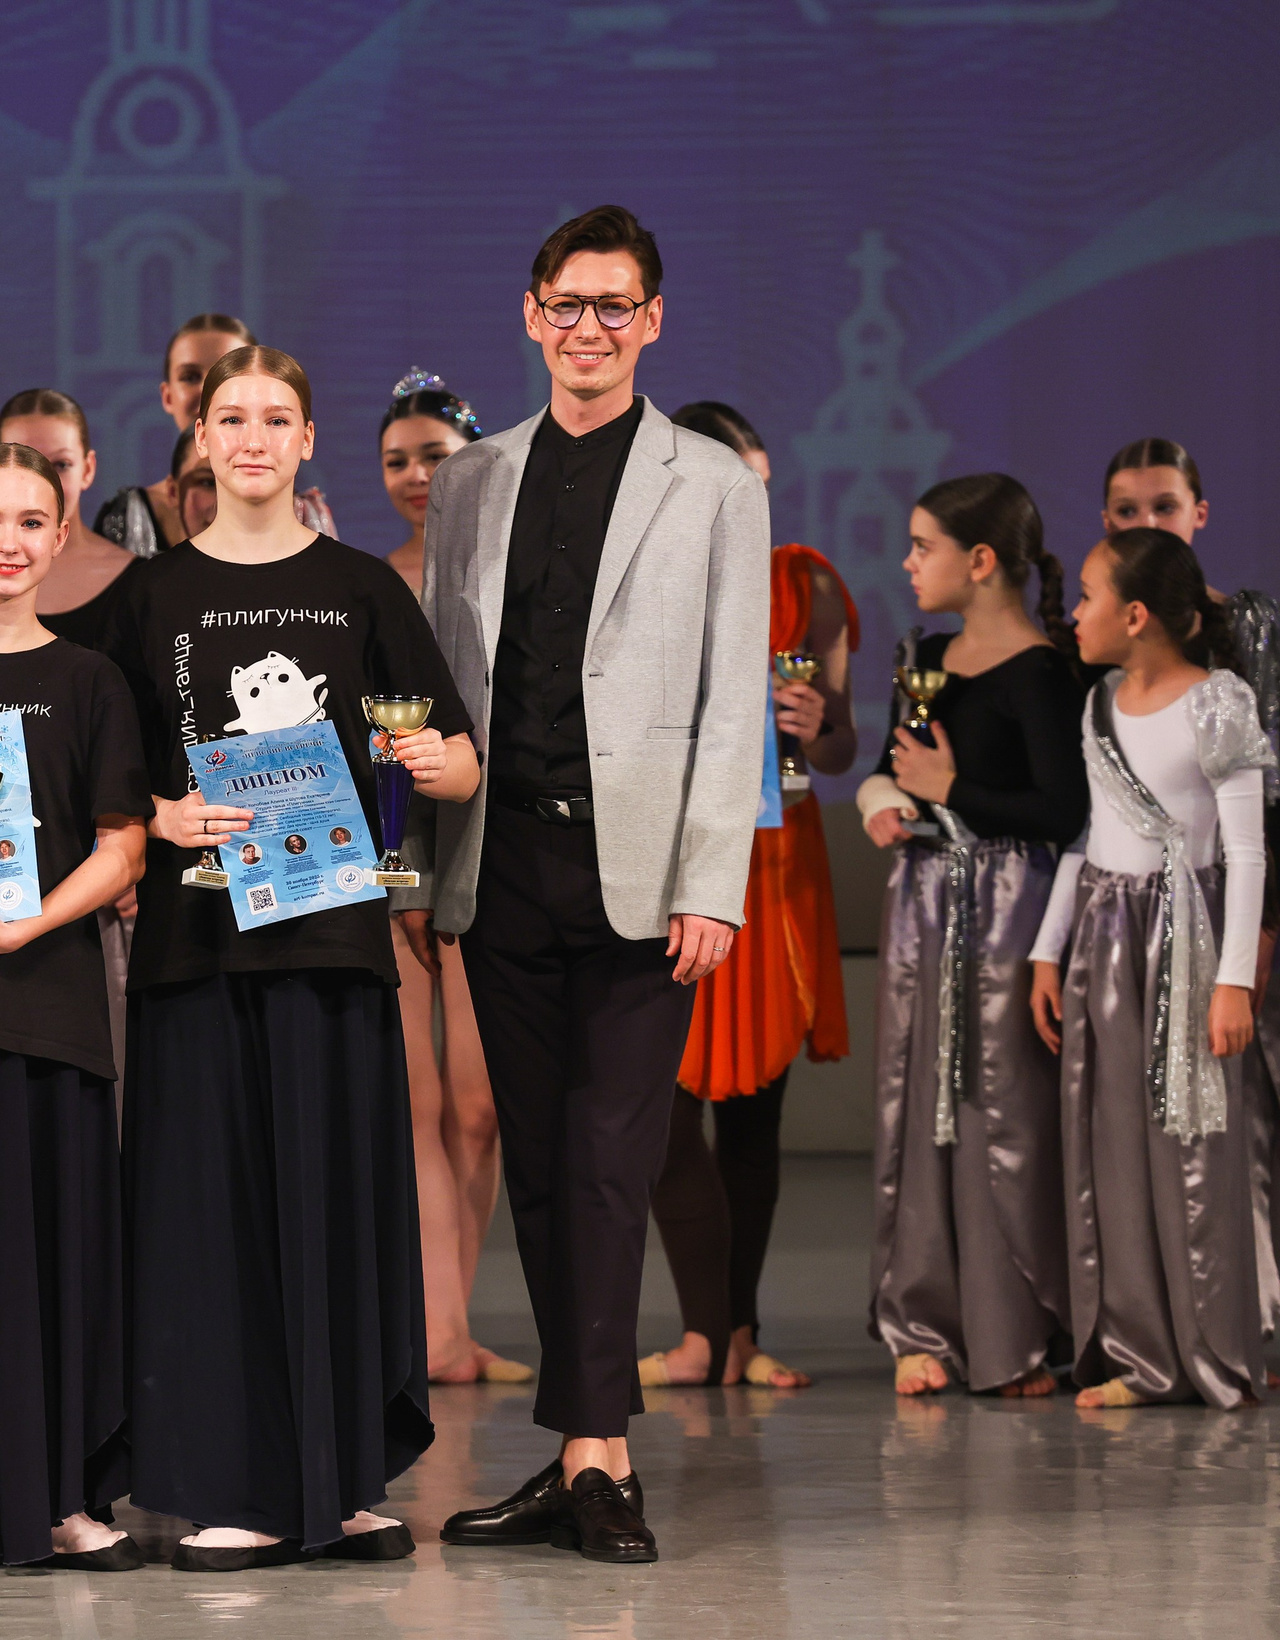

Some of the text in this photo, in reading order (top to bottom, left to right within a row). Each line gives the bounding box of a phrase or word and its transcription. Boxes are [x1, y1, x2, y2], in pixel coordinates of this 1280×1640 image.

[200, 608, 349, 628] #плигунчик
[174, 632, 200, 793] стдия_танца
[224, 763, 328, 797] ДИПЛОМ
